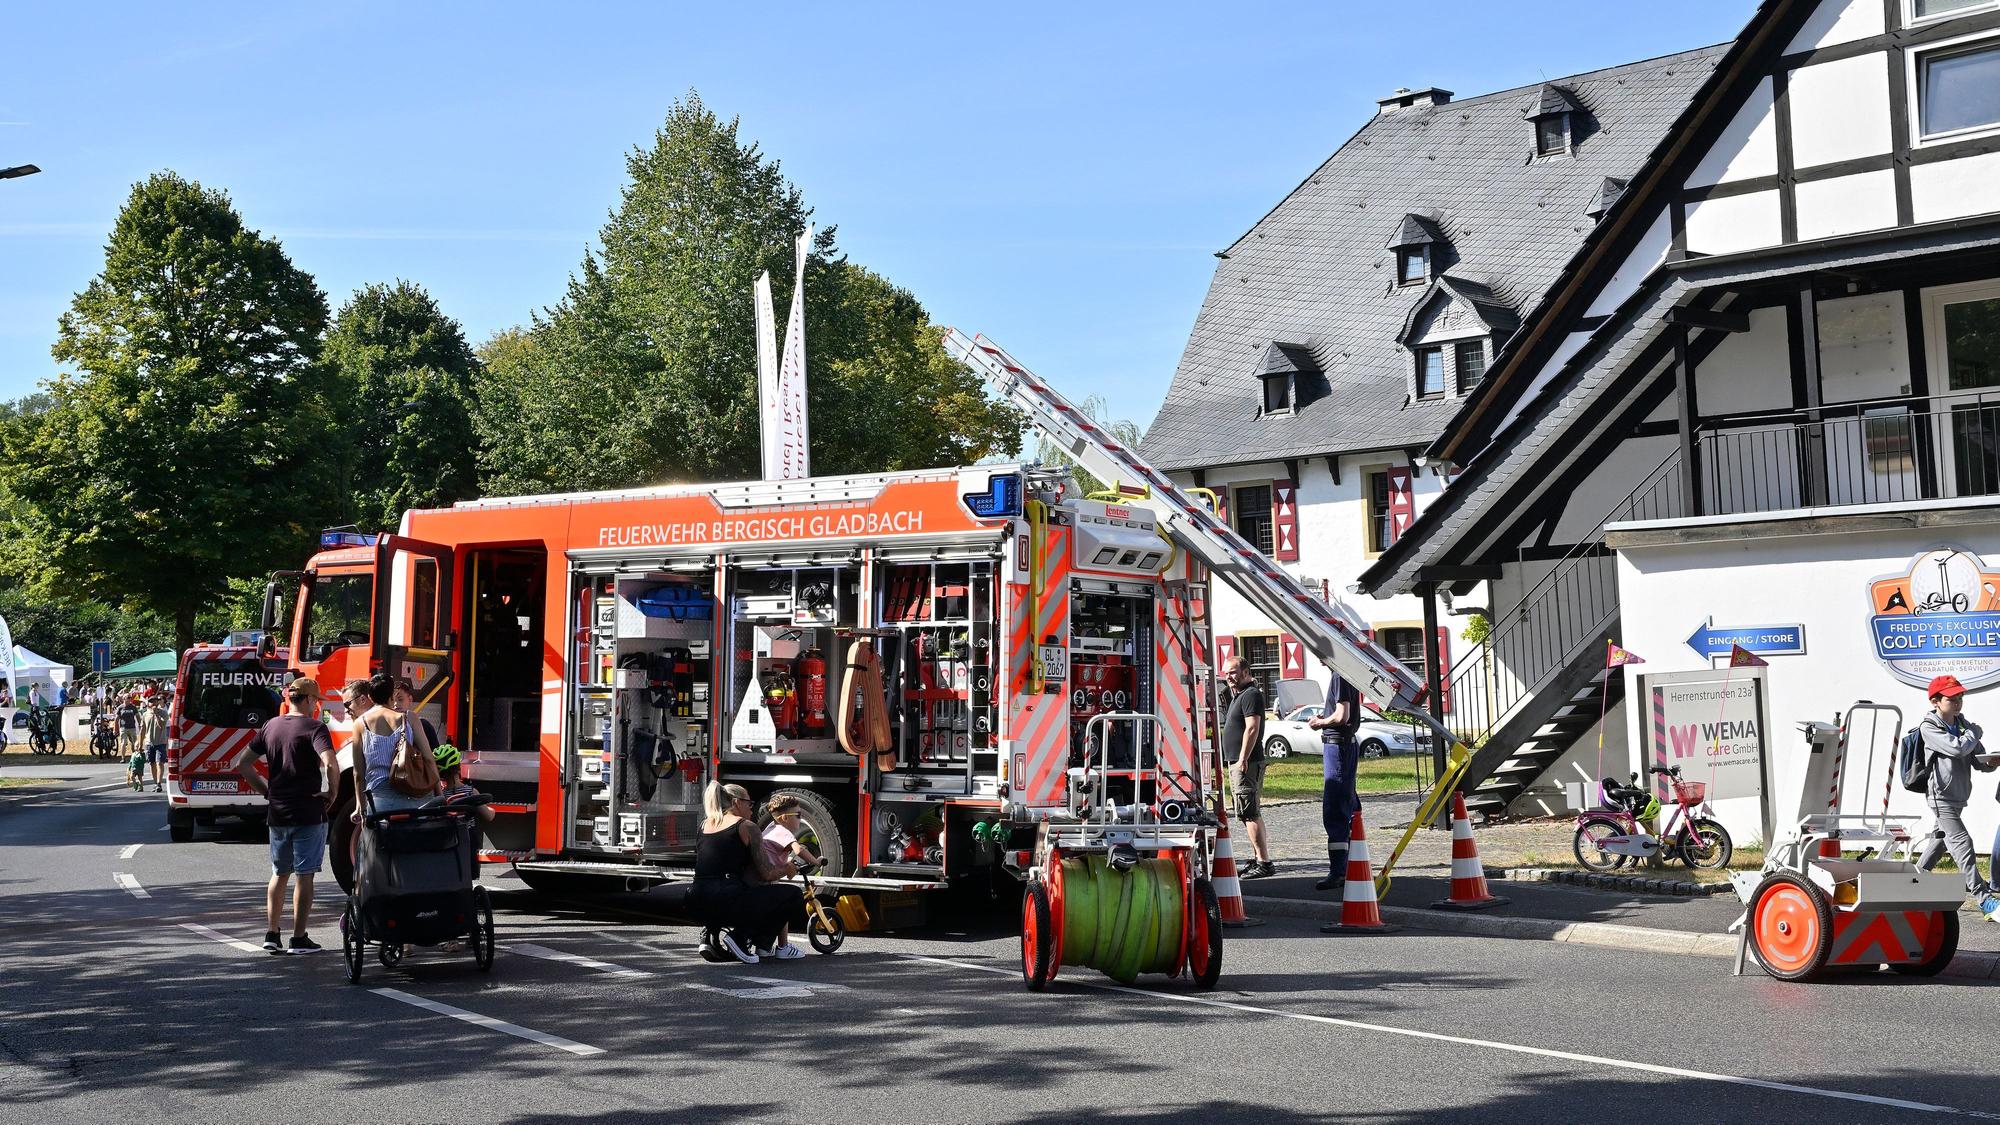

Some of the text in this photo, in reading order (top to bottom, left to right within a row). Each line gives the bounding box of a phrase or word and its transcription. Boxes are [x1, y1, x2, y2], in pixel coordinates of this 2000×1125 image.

[599, 511, 923, 546] FEUERWEHR BERGISCH GLADBACH
[1890, 622, 1943, 633] FREDDY'S
[1708, 635, 1754, 646] EINGANG
[1760, 633, 1794, 644] STORE
[1882, 634, 1928, 650] GOLF
[1044, 648, 1054, 662] GL
[1047, 662, 1064, 676] 2067
[1947, 659, 1993, 667] VERMIETUNG
[1670, 687, 1752, 703] Herrenstrunden 23a
[1701, 719, 1758, 742] WEMA
[1732, 742, 1758, 754] GmbH
[214, 761, 229, 769] 112
[1707, 756, 1759, 768] www.wemacare.de
[220, 782, 237, 790] 2024
